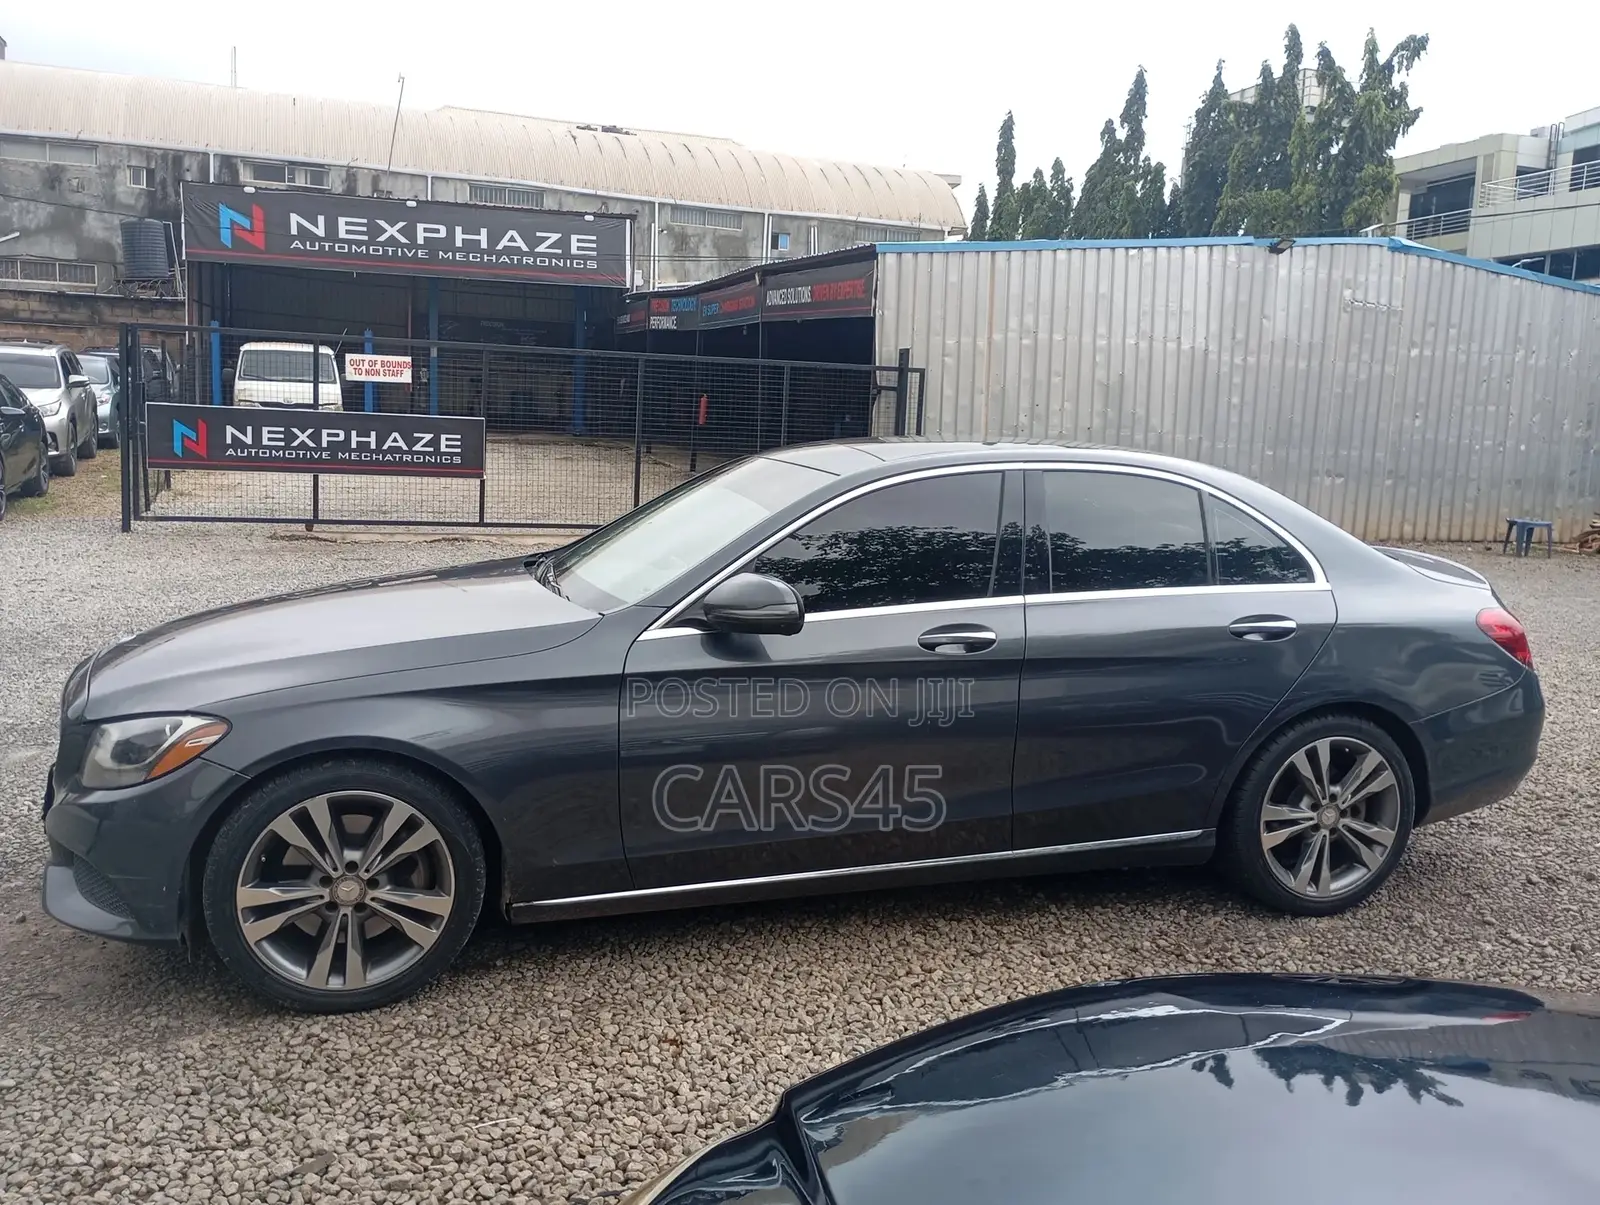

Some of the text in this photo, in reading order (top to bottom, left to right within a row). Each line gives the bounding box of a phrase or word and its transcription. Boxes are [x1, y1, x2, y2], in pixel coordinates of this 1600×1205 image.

[289, 212, 598, 257] NEXPHAZE
[289, 240, 598, 269] AUTOMOTIVE MECHATRONICS
[350, 358, 411, 369] OUT OF BOUNDS
[353, 368, 363, 376] TO
[365, 368, 380, 376] NON
[226, 424, 462, 453] NEXPHAZE
[226, 448, 462, 464] AUTOMOTIVE MECHATRONICS
